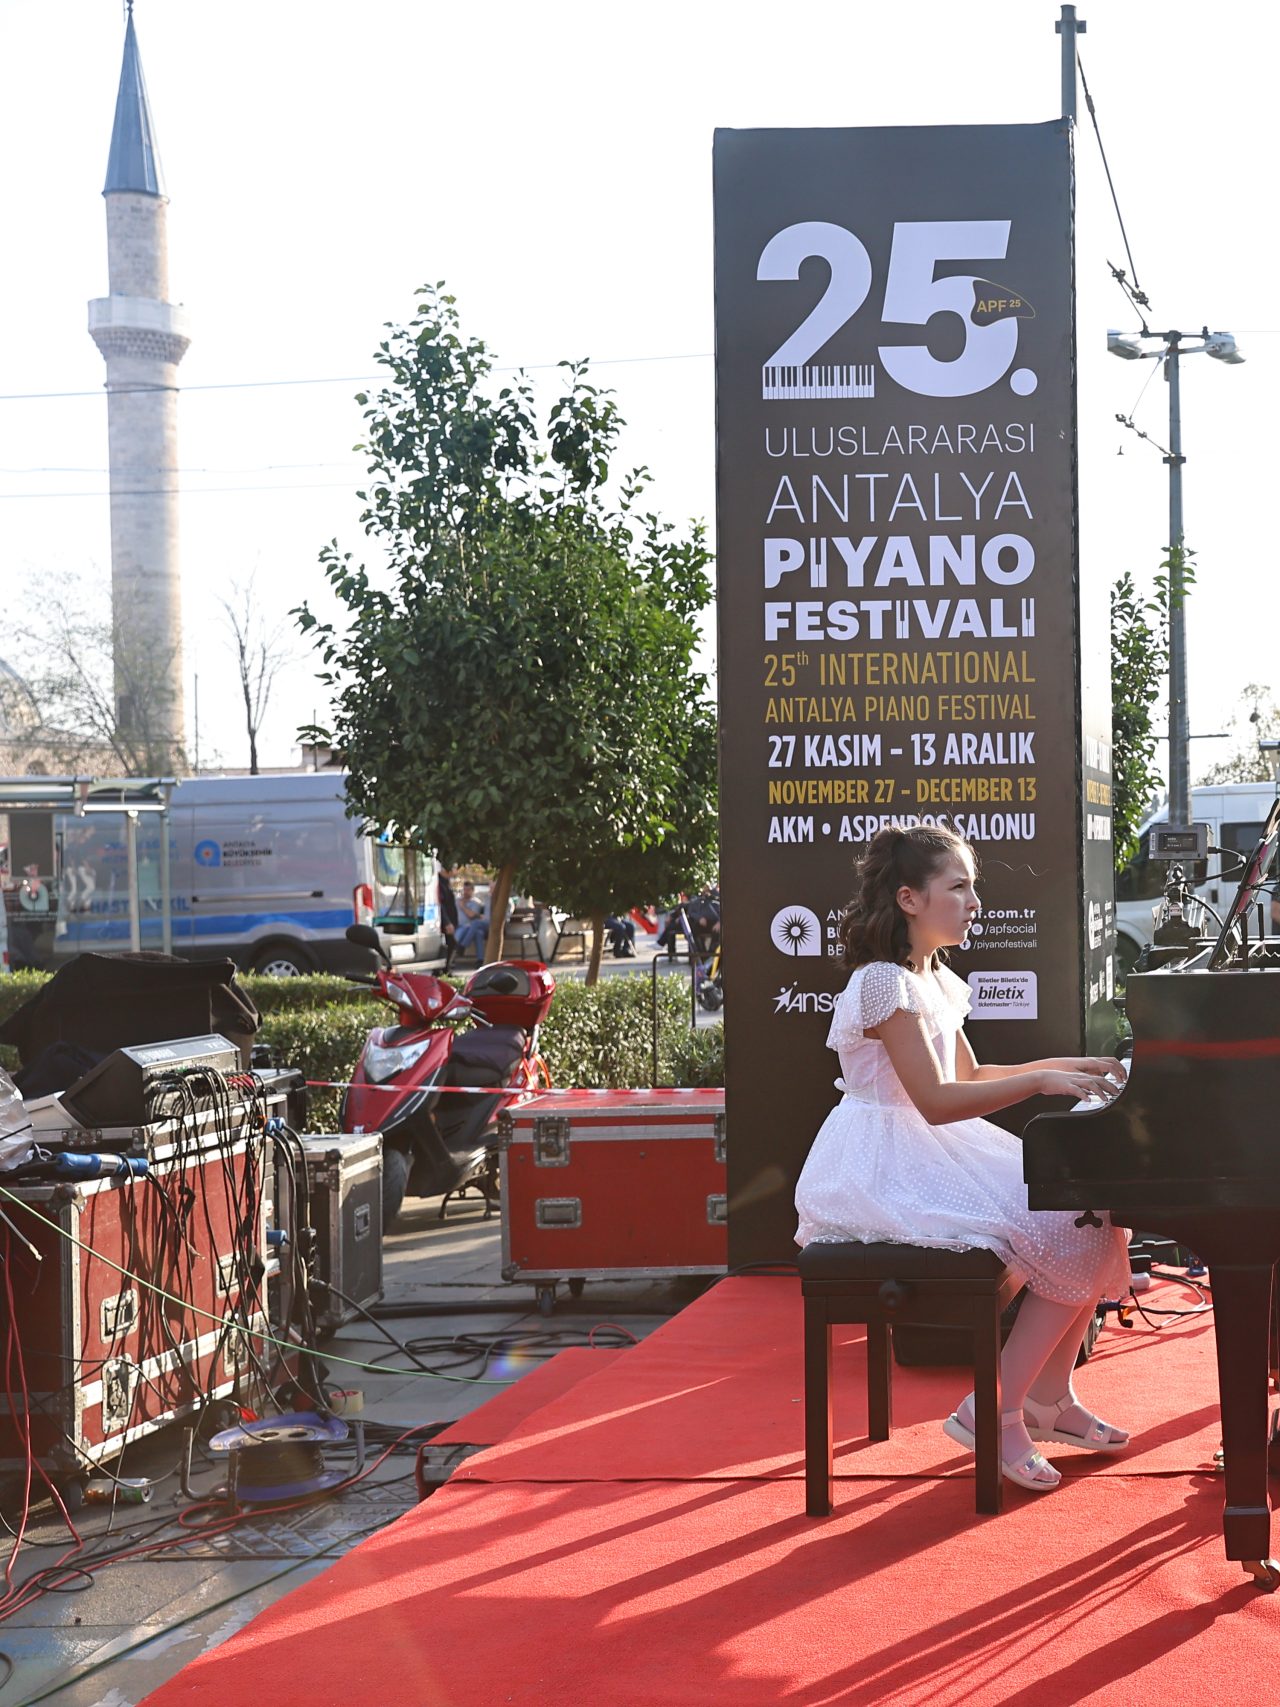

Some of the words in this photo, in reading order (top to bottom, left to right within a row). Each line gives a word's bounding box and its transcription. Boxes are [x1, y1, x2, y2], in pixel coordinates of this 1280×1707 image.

[756, 220, 1038, 399] 25.
[977, 300, 1007, 313] APF
[1009, 300, 1021, 308] 25
[765, 423, 1035, 457] ULUSLARARASI
[766, 471, 1033, 524] ANTALYA
[764, 650, 809, 687] 25th
[820, 650, 1035, 686] INTERNATIONAL
[765, 697, 856, 724] ANTALYA
[865, 696, 930, 722] PIANO
[938, 695, 1035, 721] FESTIVAL
[768, 735, 796, 768] 27
[804, 733, 881, 767] KASIM
[911, 733, 935, 765] 13
[943, 732, 1035, 765] ARALIK
[769, 779, 869, 805] NOVEMBER
[874, 779, 894, 803] 27
[916, 778, 1012, 803] DECEMBER
[1018, 777, 1036, 801] 13
[768, 816, 814, 843] AKM
[953, 812, 1036, 842] SALONU
[985, 923, 1037, 935] /apfsocial
[973, 940, 1037, 950] /piyanofestivali
[978, 986, 1024, 999] biletix
